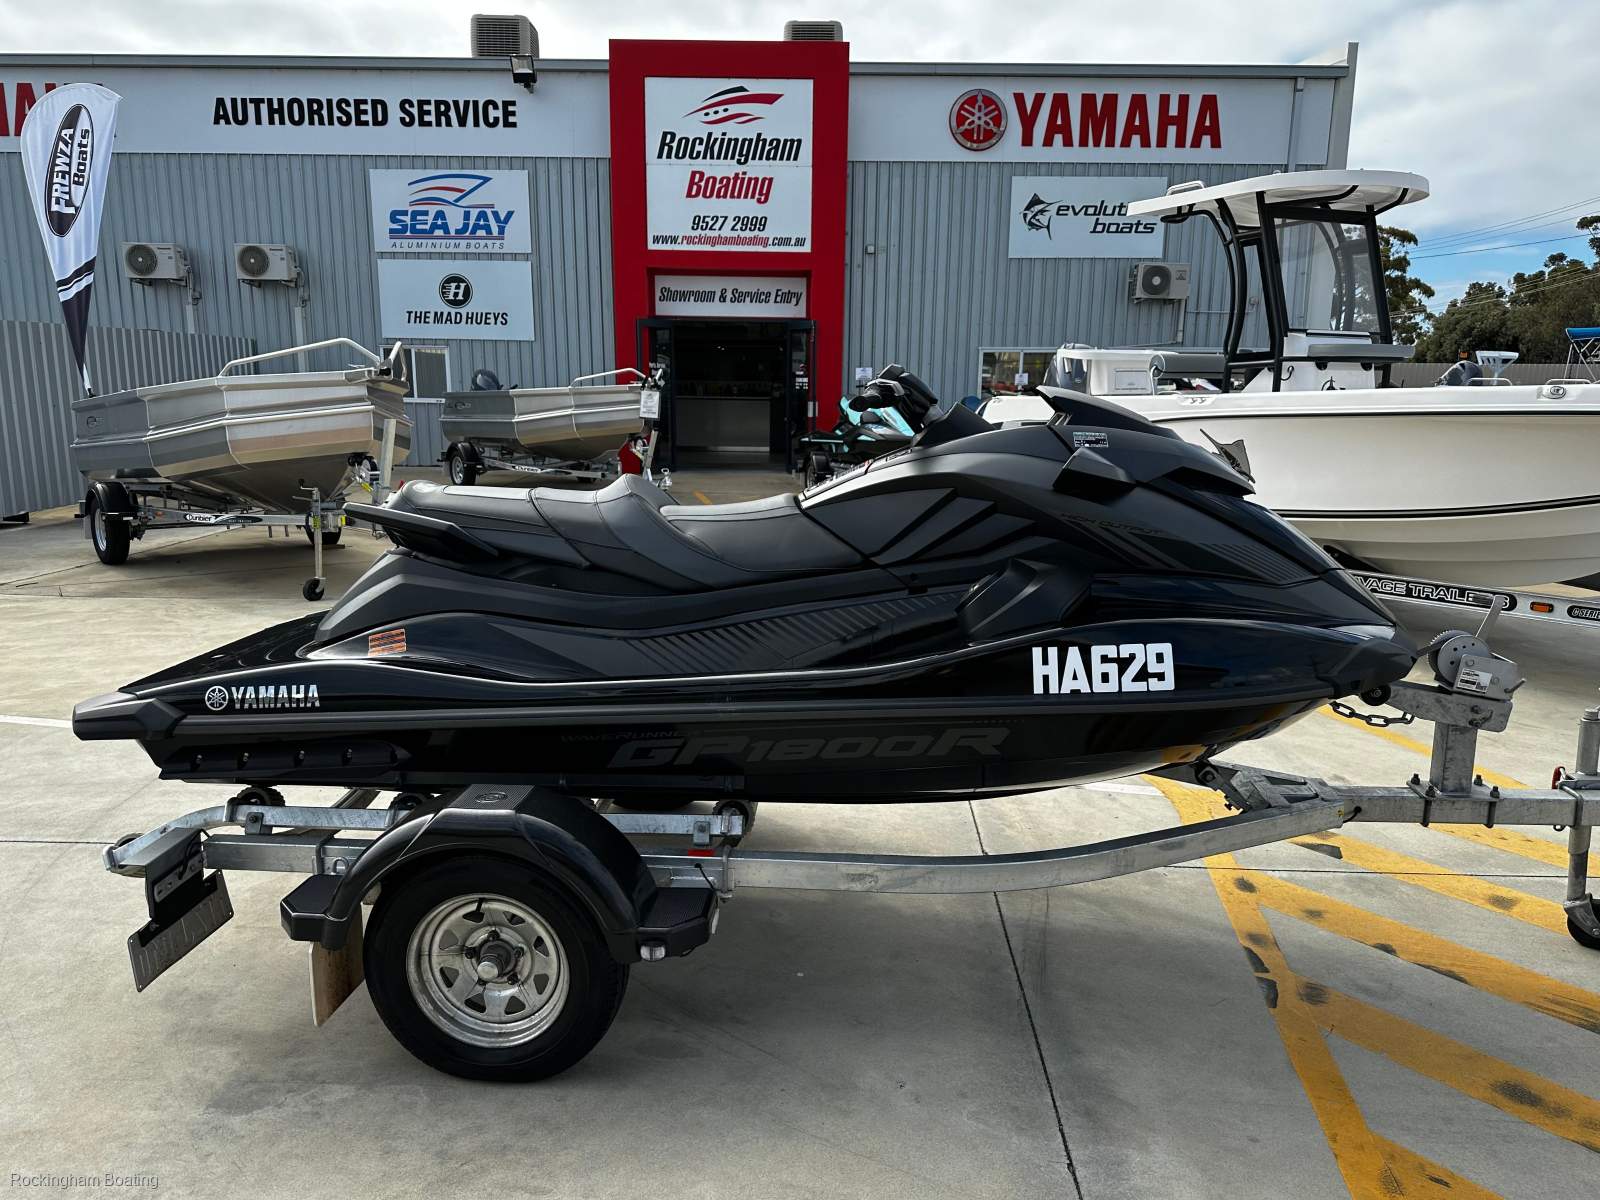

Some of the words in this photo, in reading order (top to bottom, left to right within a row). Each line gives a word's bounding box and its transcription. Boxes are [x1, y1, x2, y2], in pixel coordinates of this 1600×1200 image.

[214, 97, 389, 127] AUTHORISED
[400, 99, 518, 129] SERVICE
[1013, 92, 1223, 149] YAMAHA
[72, 128, 91, 187] Boats
[657, 131, 802, 165] Rockingham
[51, 128, 76, 215] FREWZA
[685, 170, 774, 204] Boating
[388, 209, 450, 235] SEA
[454, 210, 515, 236] JAY
[691, 215, 727, 232] 9527
[730, 216, 768, 232] 2999
[1089, 217, 1157, 234] boats
[391, 241, 461, 250] ALUMINIUM
[466, 242, 505, 250] BOATS
[652, 234, 806, 248] www.rockinghamboating.com.au
[658, 287, 716, 303] Showroom
[718, 288, 727, 303] &
[730, 288, 770, 304] Service
[773, 289, 803, 306] Entry
[406, 310, 431, 325] THE
[433, 311, 463, 325] MAD
[465, 312, 509, 326] HUEYS
[1032, 642, 1175, 695] HA629
[231, 684, 320, 709] YAMAHA
[607, 726, 1011, 769] GP1800R
